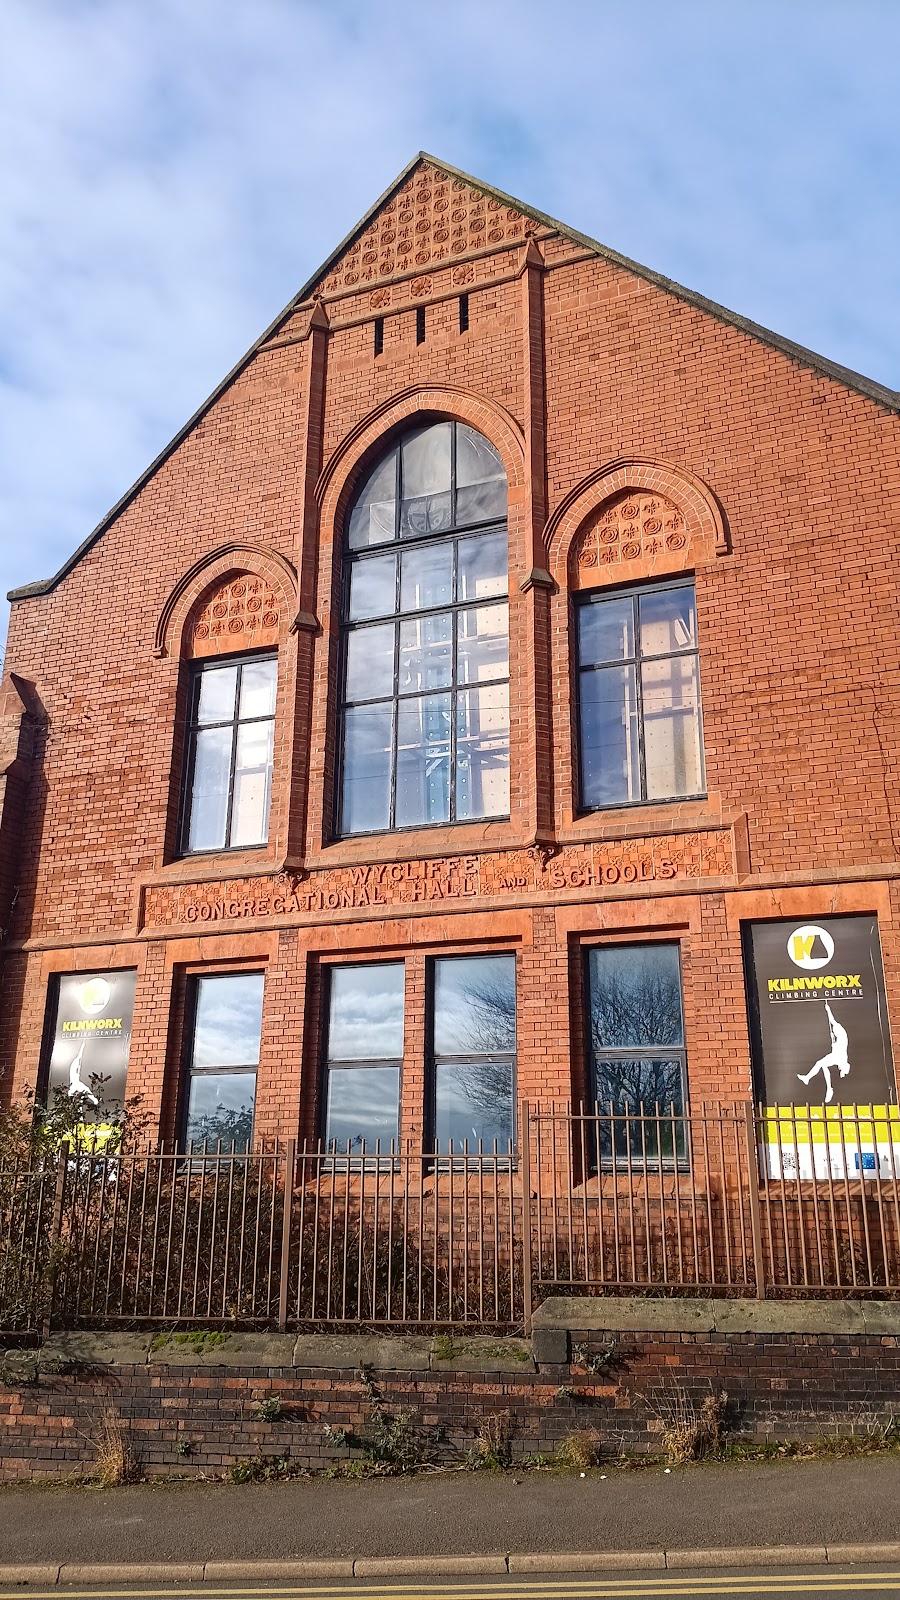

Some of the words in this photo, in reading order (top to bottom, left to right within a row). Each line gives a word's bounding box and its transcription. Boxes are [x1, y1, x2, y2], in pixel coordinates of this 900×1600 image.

[348, 856, 479, 885] WYCLIFFE
[185, 887, 387, 922] CONGREGATIONAL
[412, 876, 478, 901] HALL
[499, 875, 527, 889] AND
[549, 858, 677, 889] SCHOOLS
[767, 975, 862, 992] KILNWORX
[768, 991, 818, 1000] CLIMBING
[824, 989, 864, 997] CENTRE
[62, 1018, 123, 1032] KILNWORX
[95, 1029, 122, 1037] CENTRE
